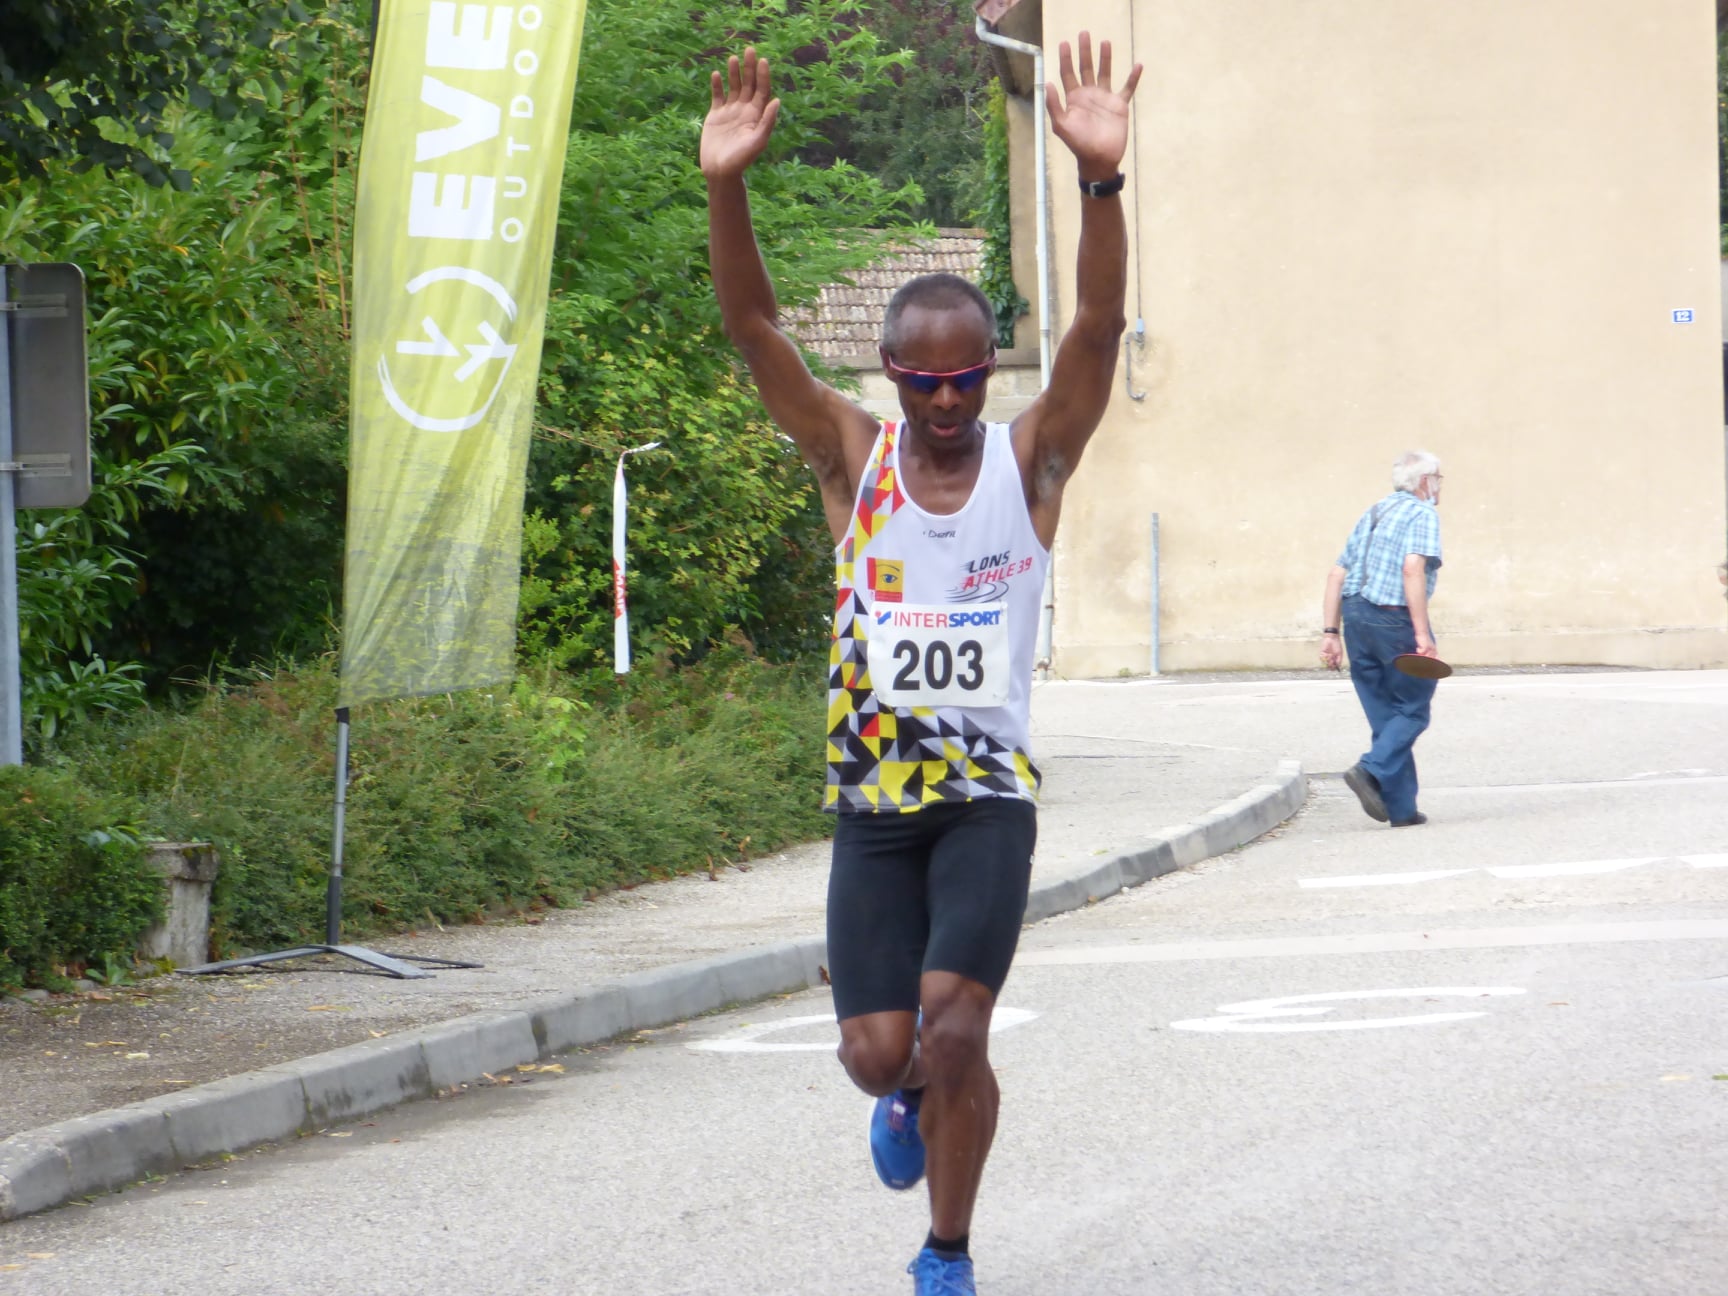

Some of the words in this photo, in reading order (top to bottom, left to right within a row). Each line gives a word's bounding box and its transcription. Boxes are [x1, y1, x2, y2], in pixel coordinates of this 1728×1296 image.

[500, 4, 542, 243] OUTDOO
[1676, 310, 1690, 322] 12
[963, 563, 1016, 591] ATHLE
[1017, 556, 1033, 574] 39
[968, 550, 1010, 574] LONS
[893, 610, 1001, 628] INTERSPORT
[892, 639, 984, 691] 203
